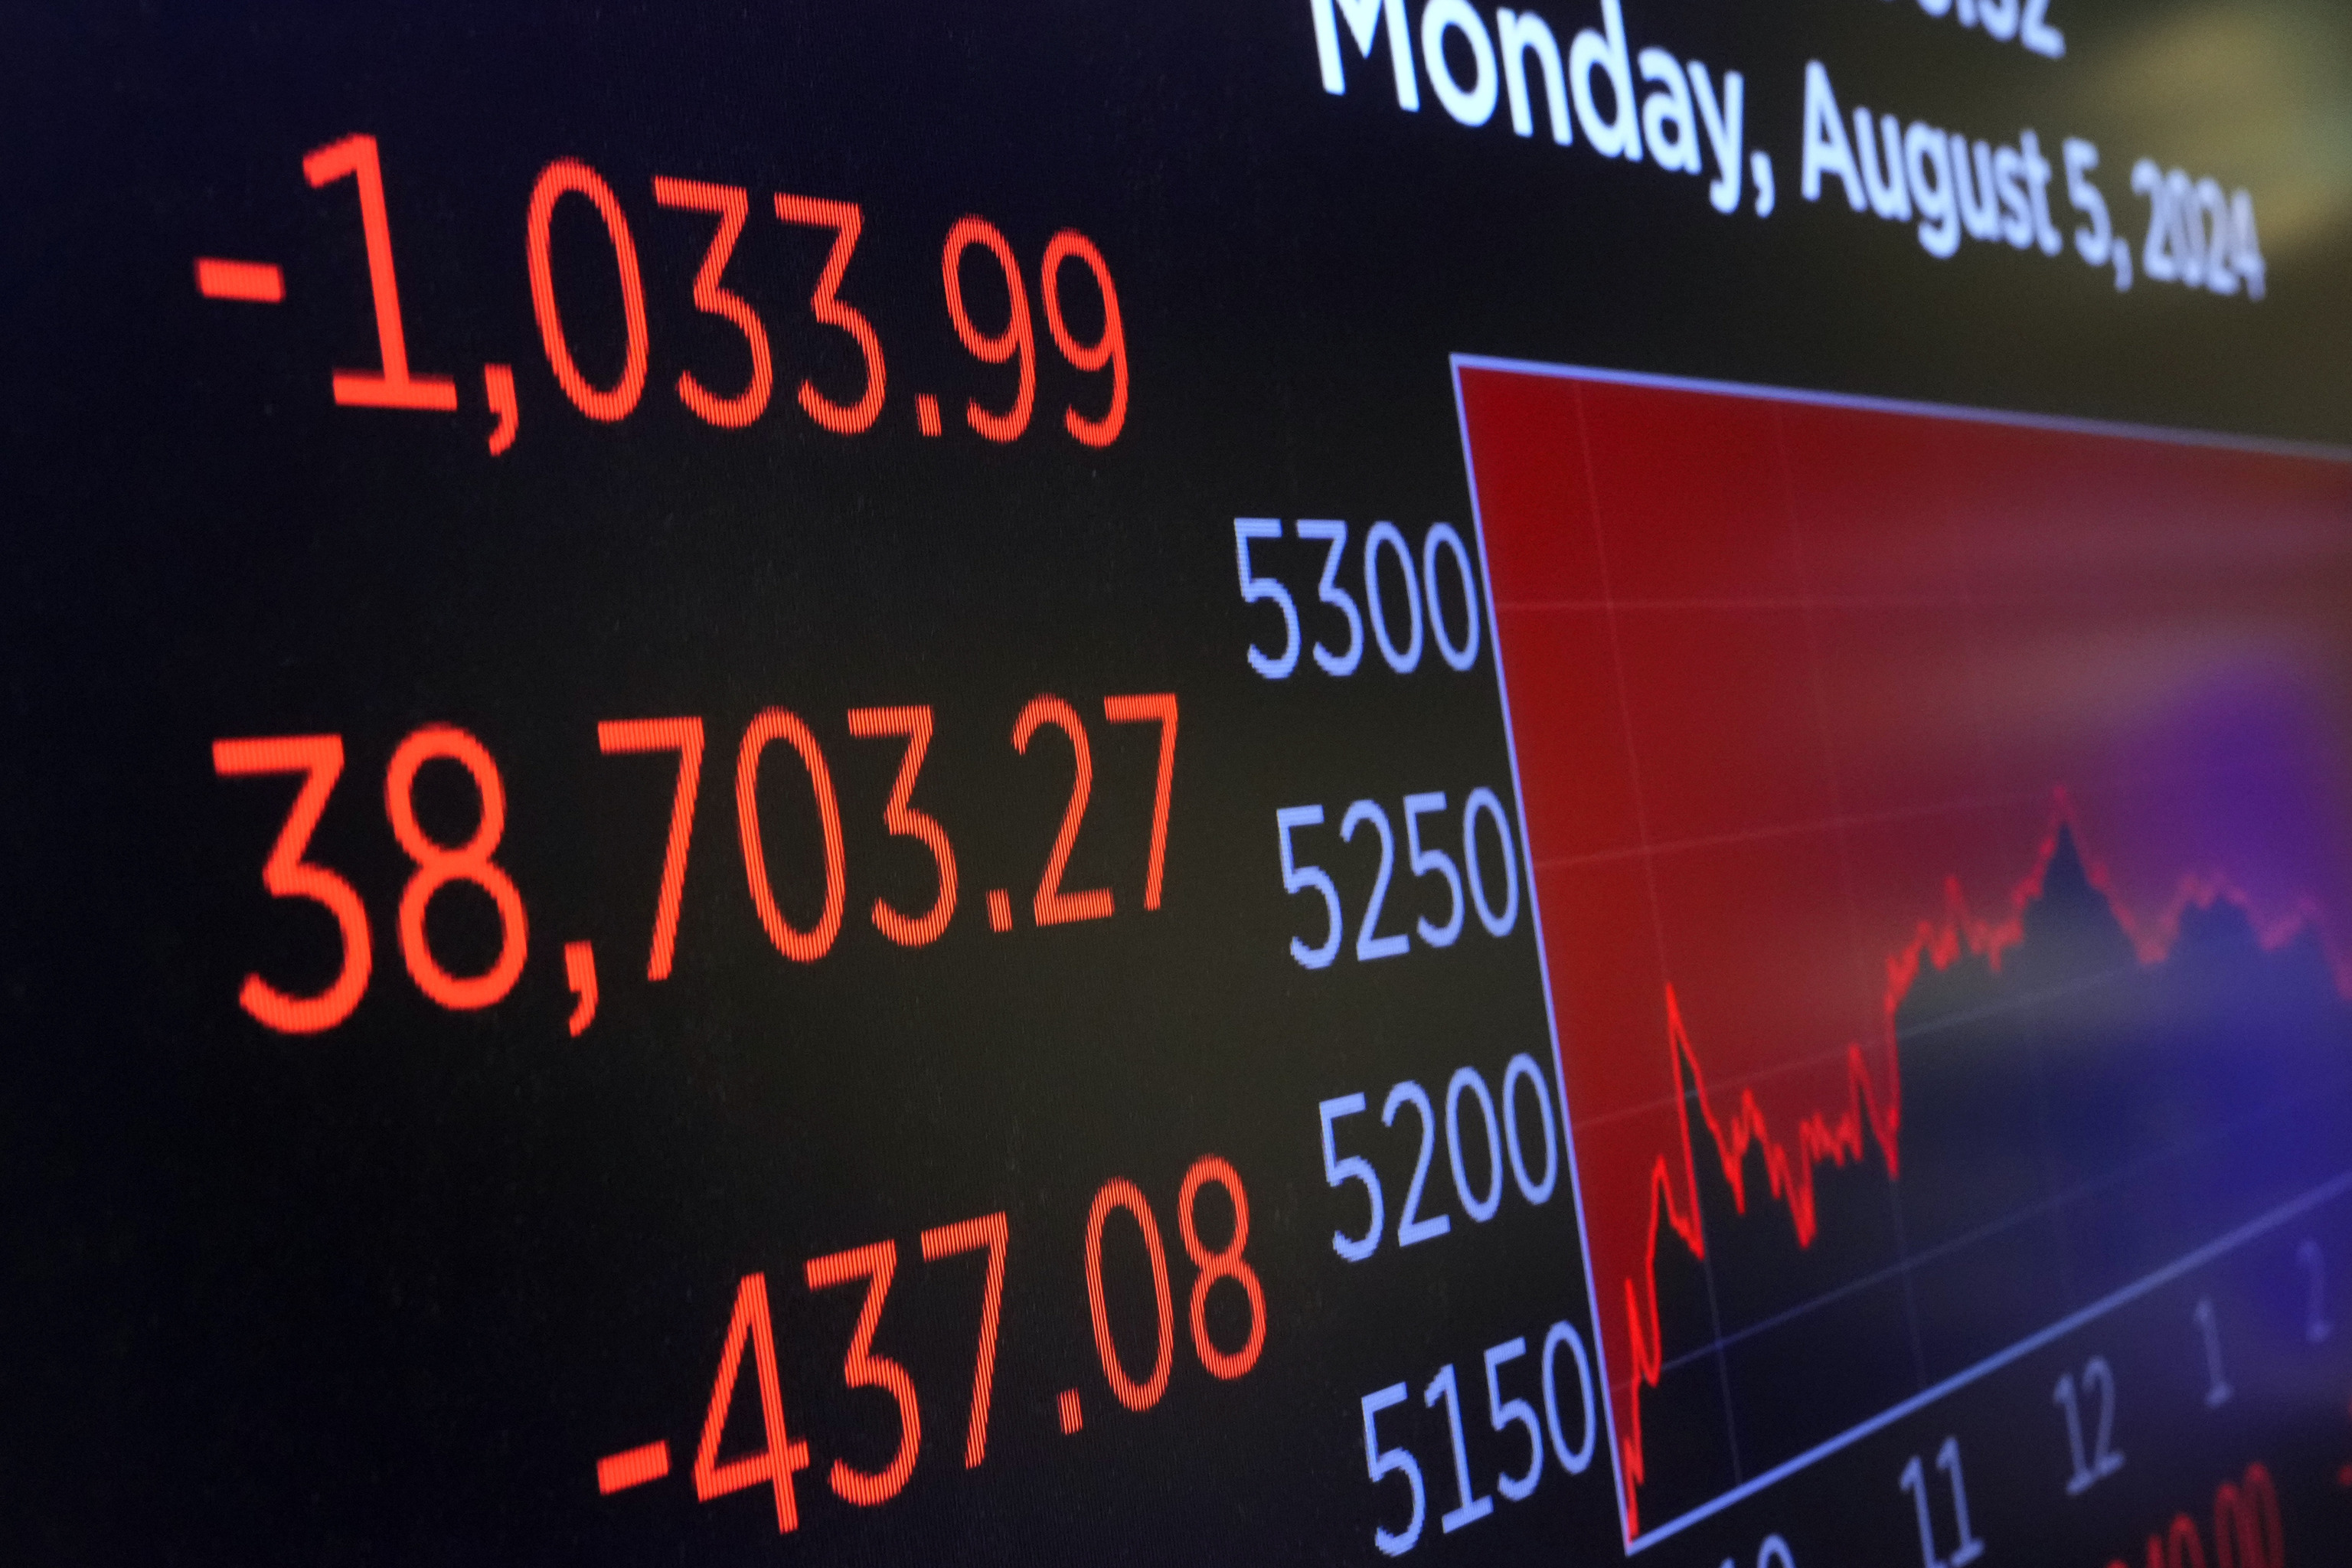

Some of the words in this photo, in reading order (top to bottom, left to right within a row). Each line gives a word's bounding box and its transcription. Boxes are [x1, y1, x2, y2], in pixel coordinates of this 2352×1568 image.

[1308, 0, 1776, 218] Monday,
[1800, 59, 2062, 259] August
[2063, 136, 2134, 292] 5,
[2130, 158, 2266, 300] 2024
[196, 133, 1129, 457] -1,033.99
[1233, 517, 1482, 679] 5300
[211, 693, 1179, 1037] 38,703.27
[1276, 786, 1520, 970] 5250
[1318, 1052, 1559, 1263] 5200
[596, 1154, 1267, 1534] -437.08
[1361, 1320, 1597, 1557] 5150
[1898, 1434, 1985, 1568] 11
[2053, 1355, 2125, 1494] 12
[2193, 1295, 2235, 1409] 1
